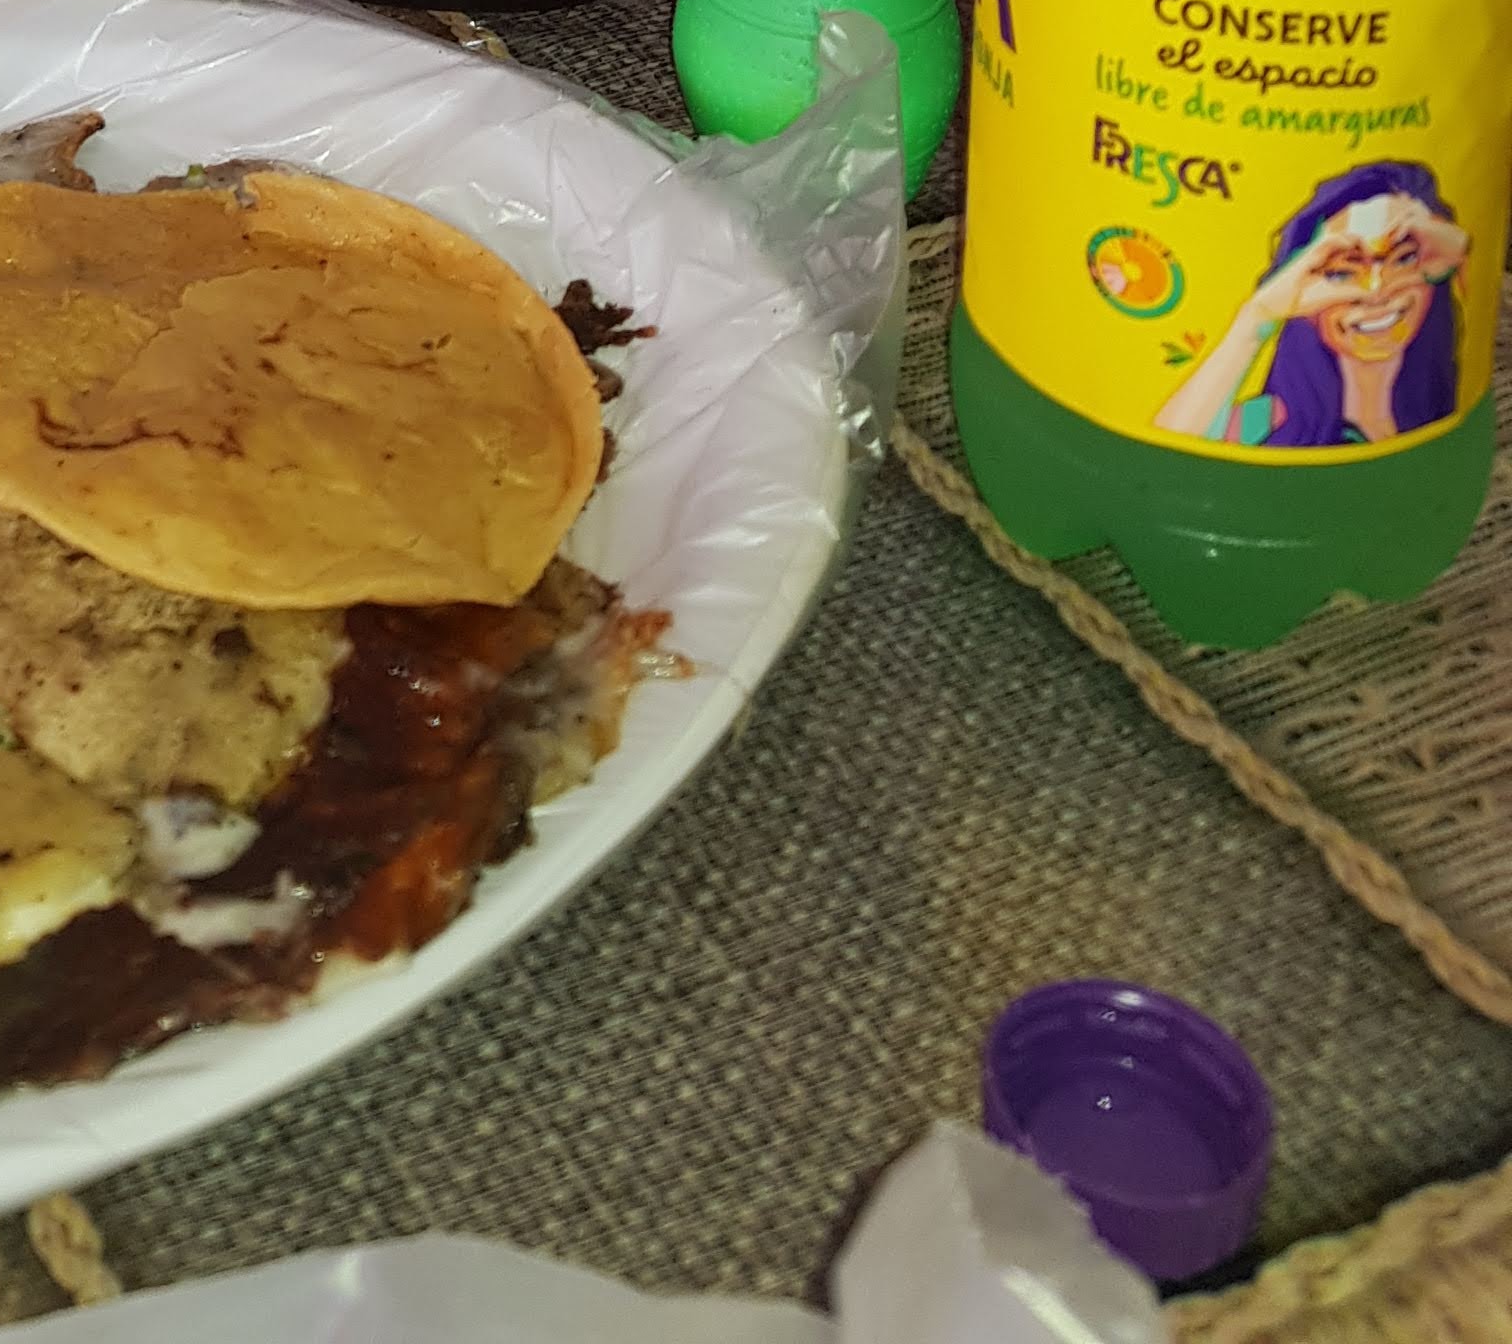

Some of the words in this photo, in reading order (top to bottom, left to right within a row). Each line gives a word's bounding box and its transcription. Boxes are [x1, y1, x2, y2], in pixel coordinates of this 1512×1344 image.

[1095, 52, 1170, 111] libre
[1182, 81, 1226, 123] de
[1240, 94, 1432, 151] amarguras
[1157, 37, 1205, 73] el
[1214, 57, 1378, 96] espacio
[1091, 114, 1233, 209] FRESCA
